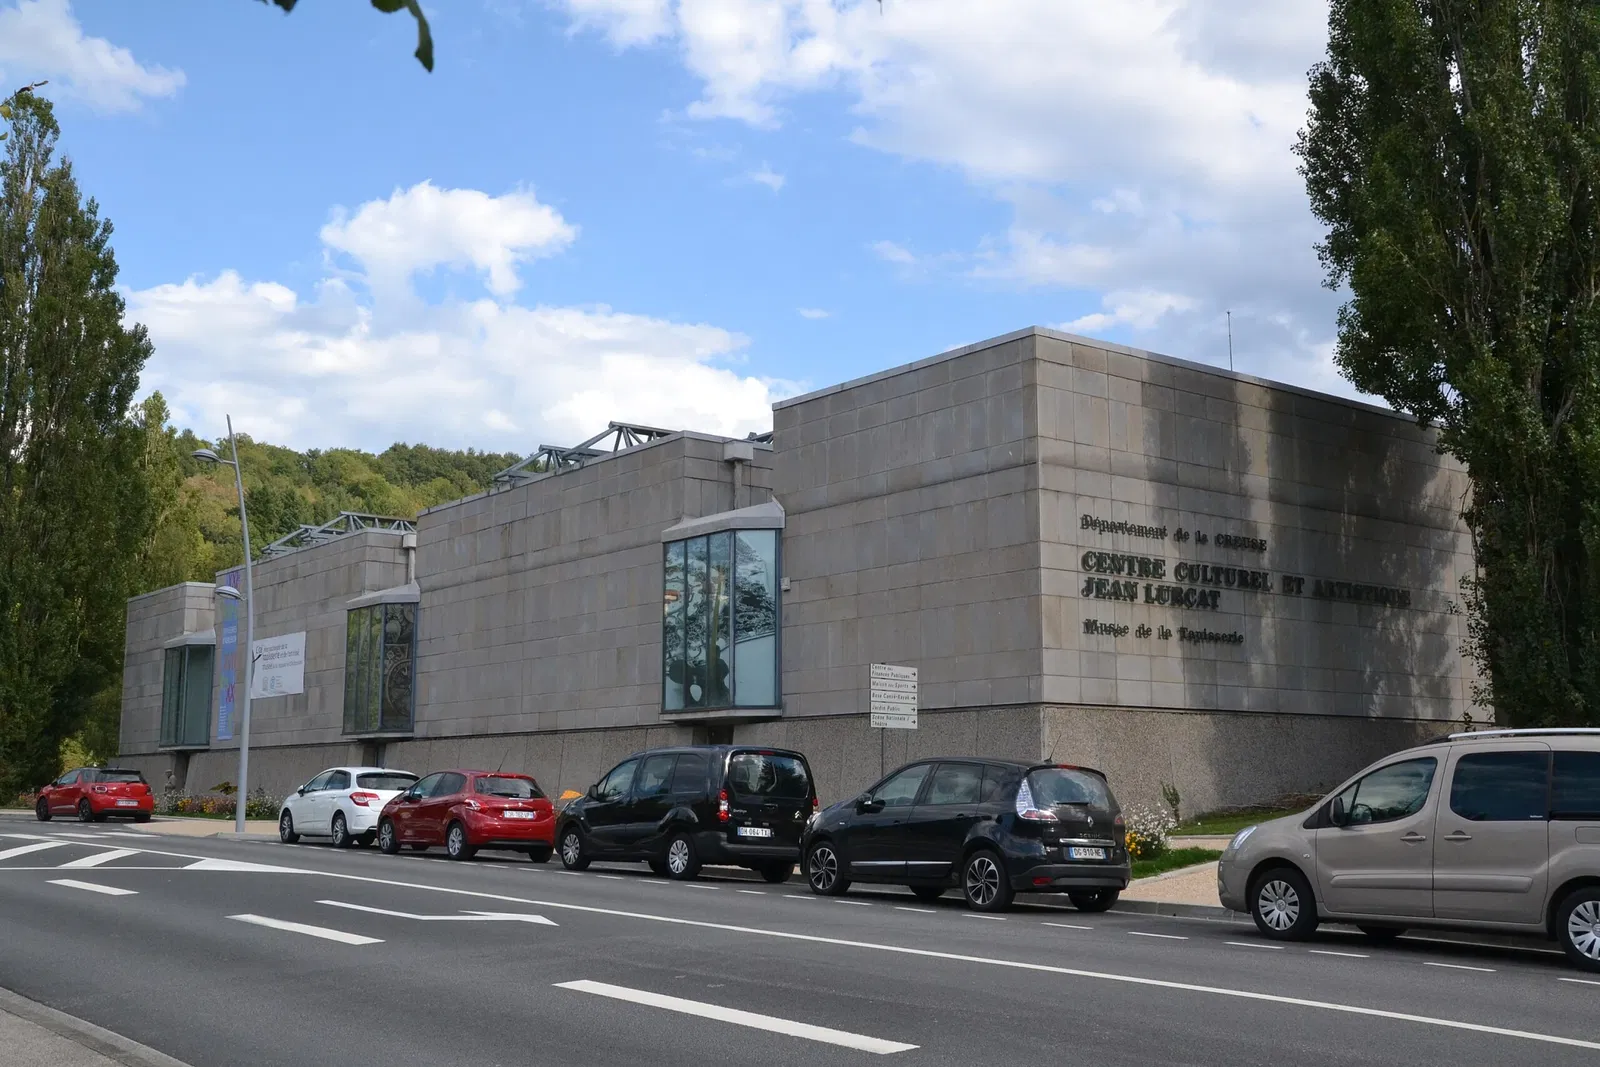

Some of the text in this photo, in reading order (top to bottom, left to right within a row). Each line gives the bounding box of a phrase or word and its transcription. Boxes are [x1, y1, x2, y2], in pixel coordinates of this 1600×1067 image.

[1080, 514, 1267, 552] Département de la CREUSE
[1081, 551, 1411, 608] CENTRE CULTUREL ET ARTISTIQUE
[1081, 577, 1139, 602] JEAN
[1135, 623, 1152, 639] de
[1157, 625, 1173, 641] la
[1178, 627, 1244, 645] Tapisserie
